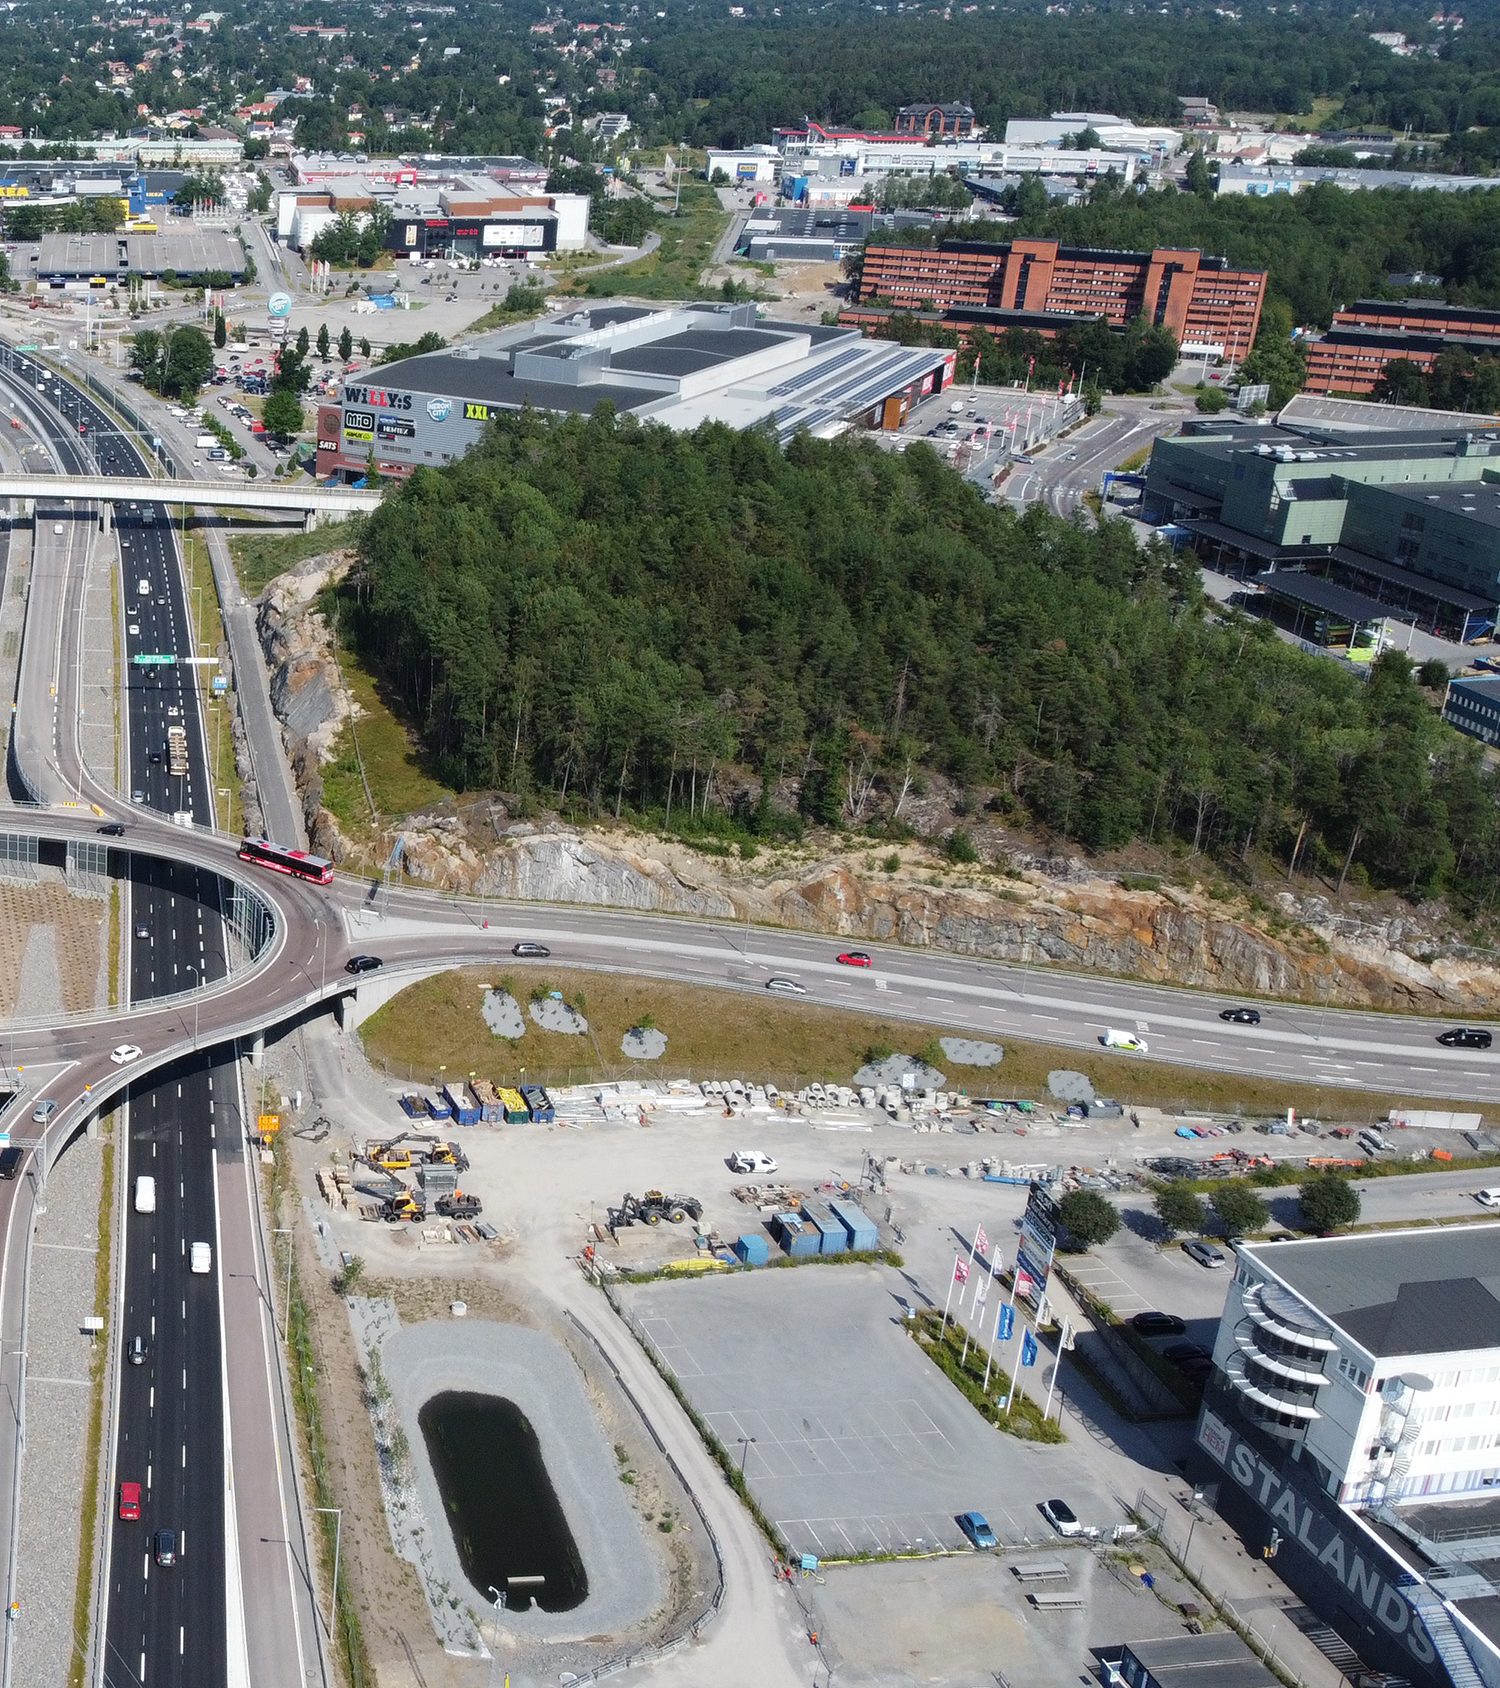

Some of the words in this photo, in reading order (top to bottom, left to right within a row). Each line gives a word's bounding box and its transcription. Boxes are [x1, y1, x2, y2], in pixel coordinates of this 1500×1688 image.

[466, 404, 488, 420] XXL
[318, 440, 337, 450] SATS
[1231, 1444, 1435, 1664] STALANDS
